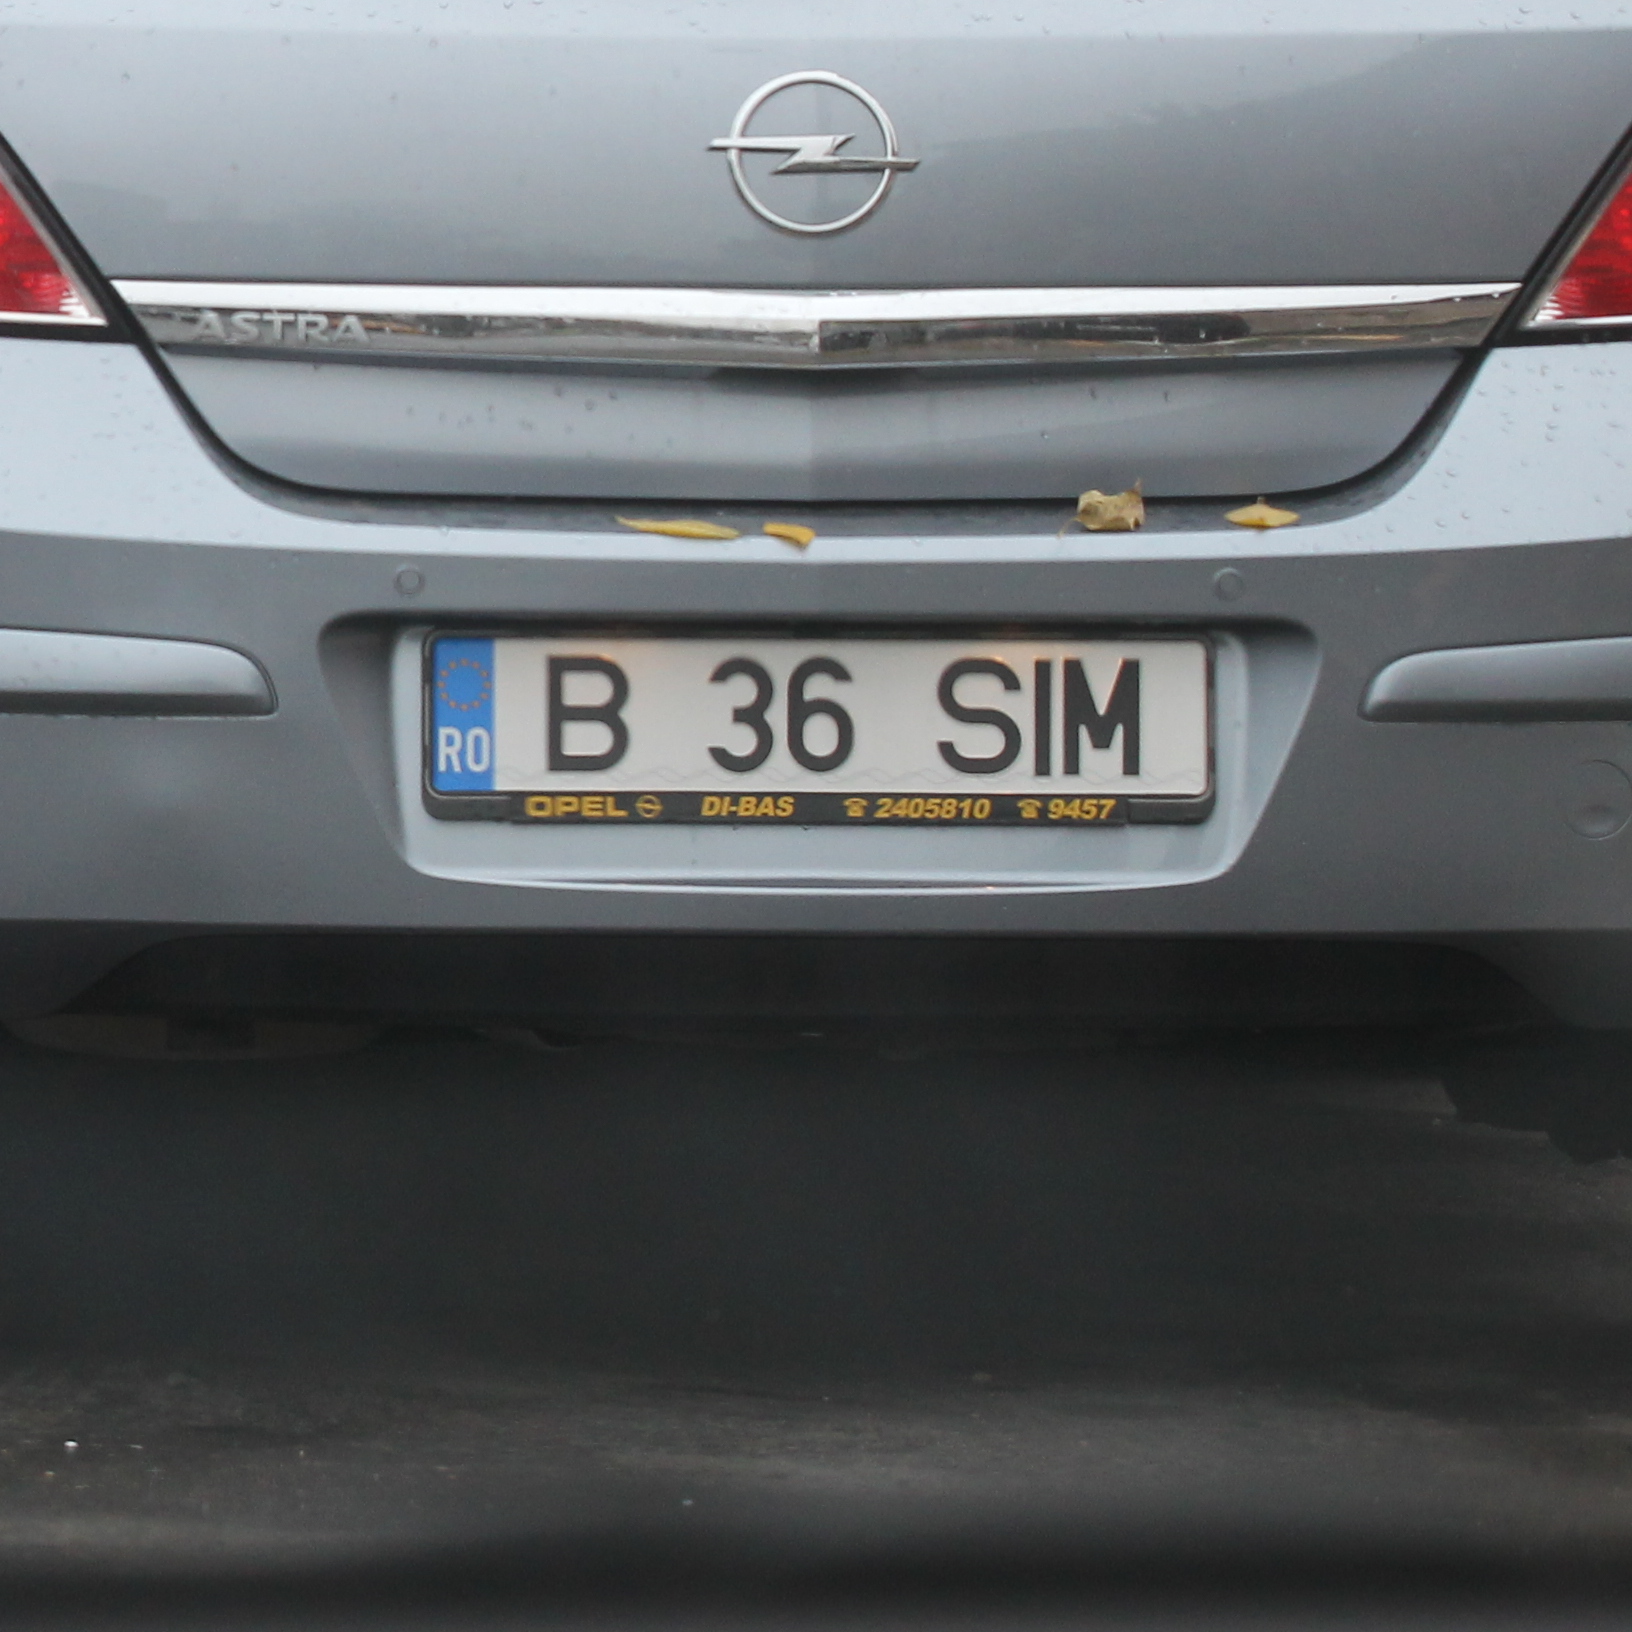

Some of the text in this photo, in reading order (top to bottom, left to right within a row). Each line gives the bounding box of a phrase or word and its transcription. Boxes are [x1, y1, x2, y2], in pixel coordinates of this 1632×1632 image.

[195, 309, 371, 344] ASTRA
[546, 655, 1142, 777] B 36 SIM
[437, 725, 492, 774] RO
[525, 795, 1117, 820] OPEL DI-BAS 2405810 9457
